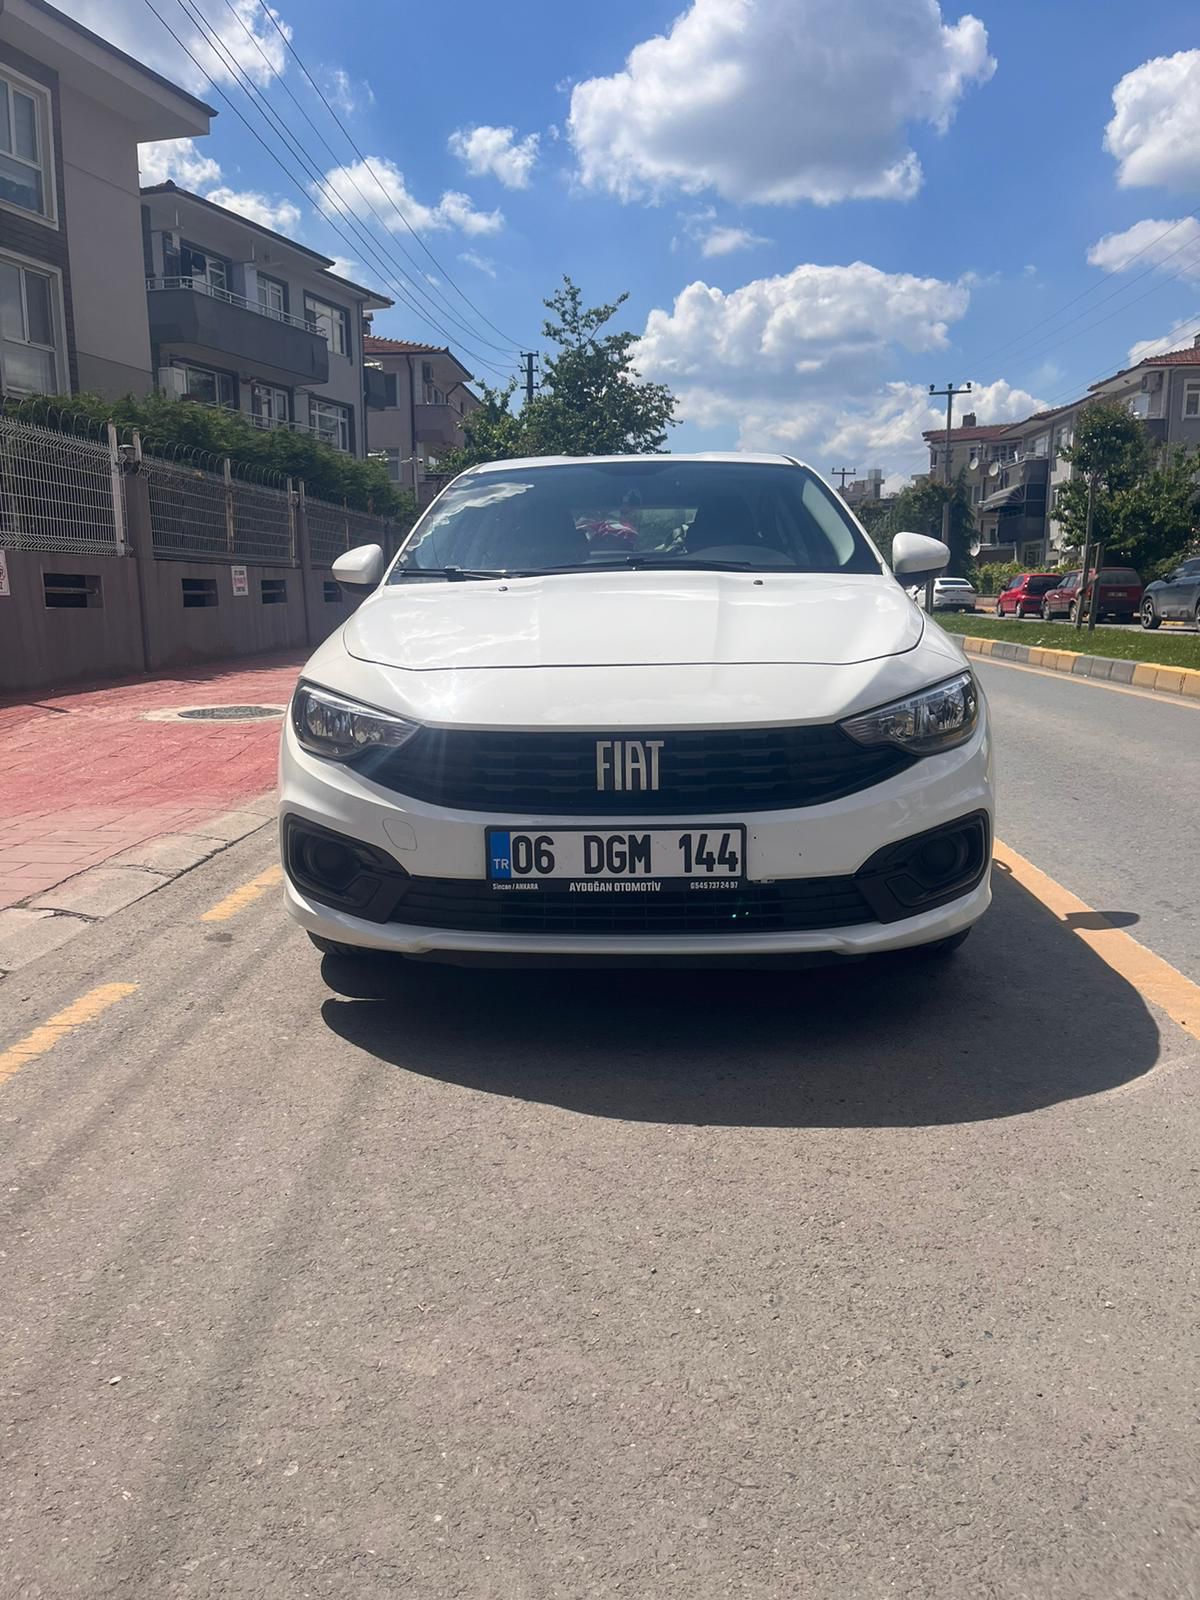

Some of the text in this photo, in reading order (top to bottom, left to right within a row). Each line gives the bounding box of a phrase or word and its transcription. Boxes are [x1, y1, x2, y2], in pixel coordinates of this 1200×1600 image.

[596, 741, 664, 790] FIAT
[492, 833, 738, 874] TR 06 DGM 144
[569, 880, 661, 892] AYDOĞAN OTOMOTİV
